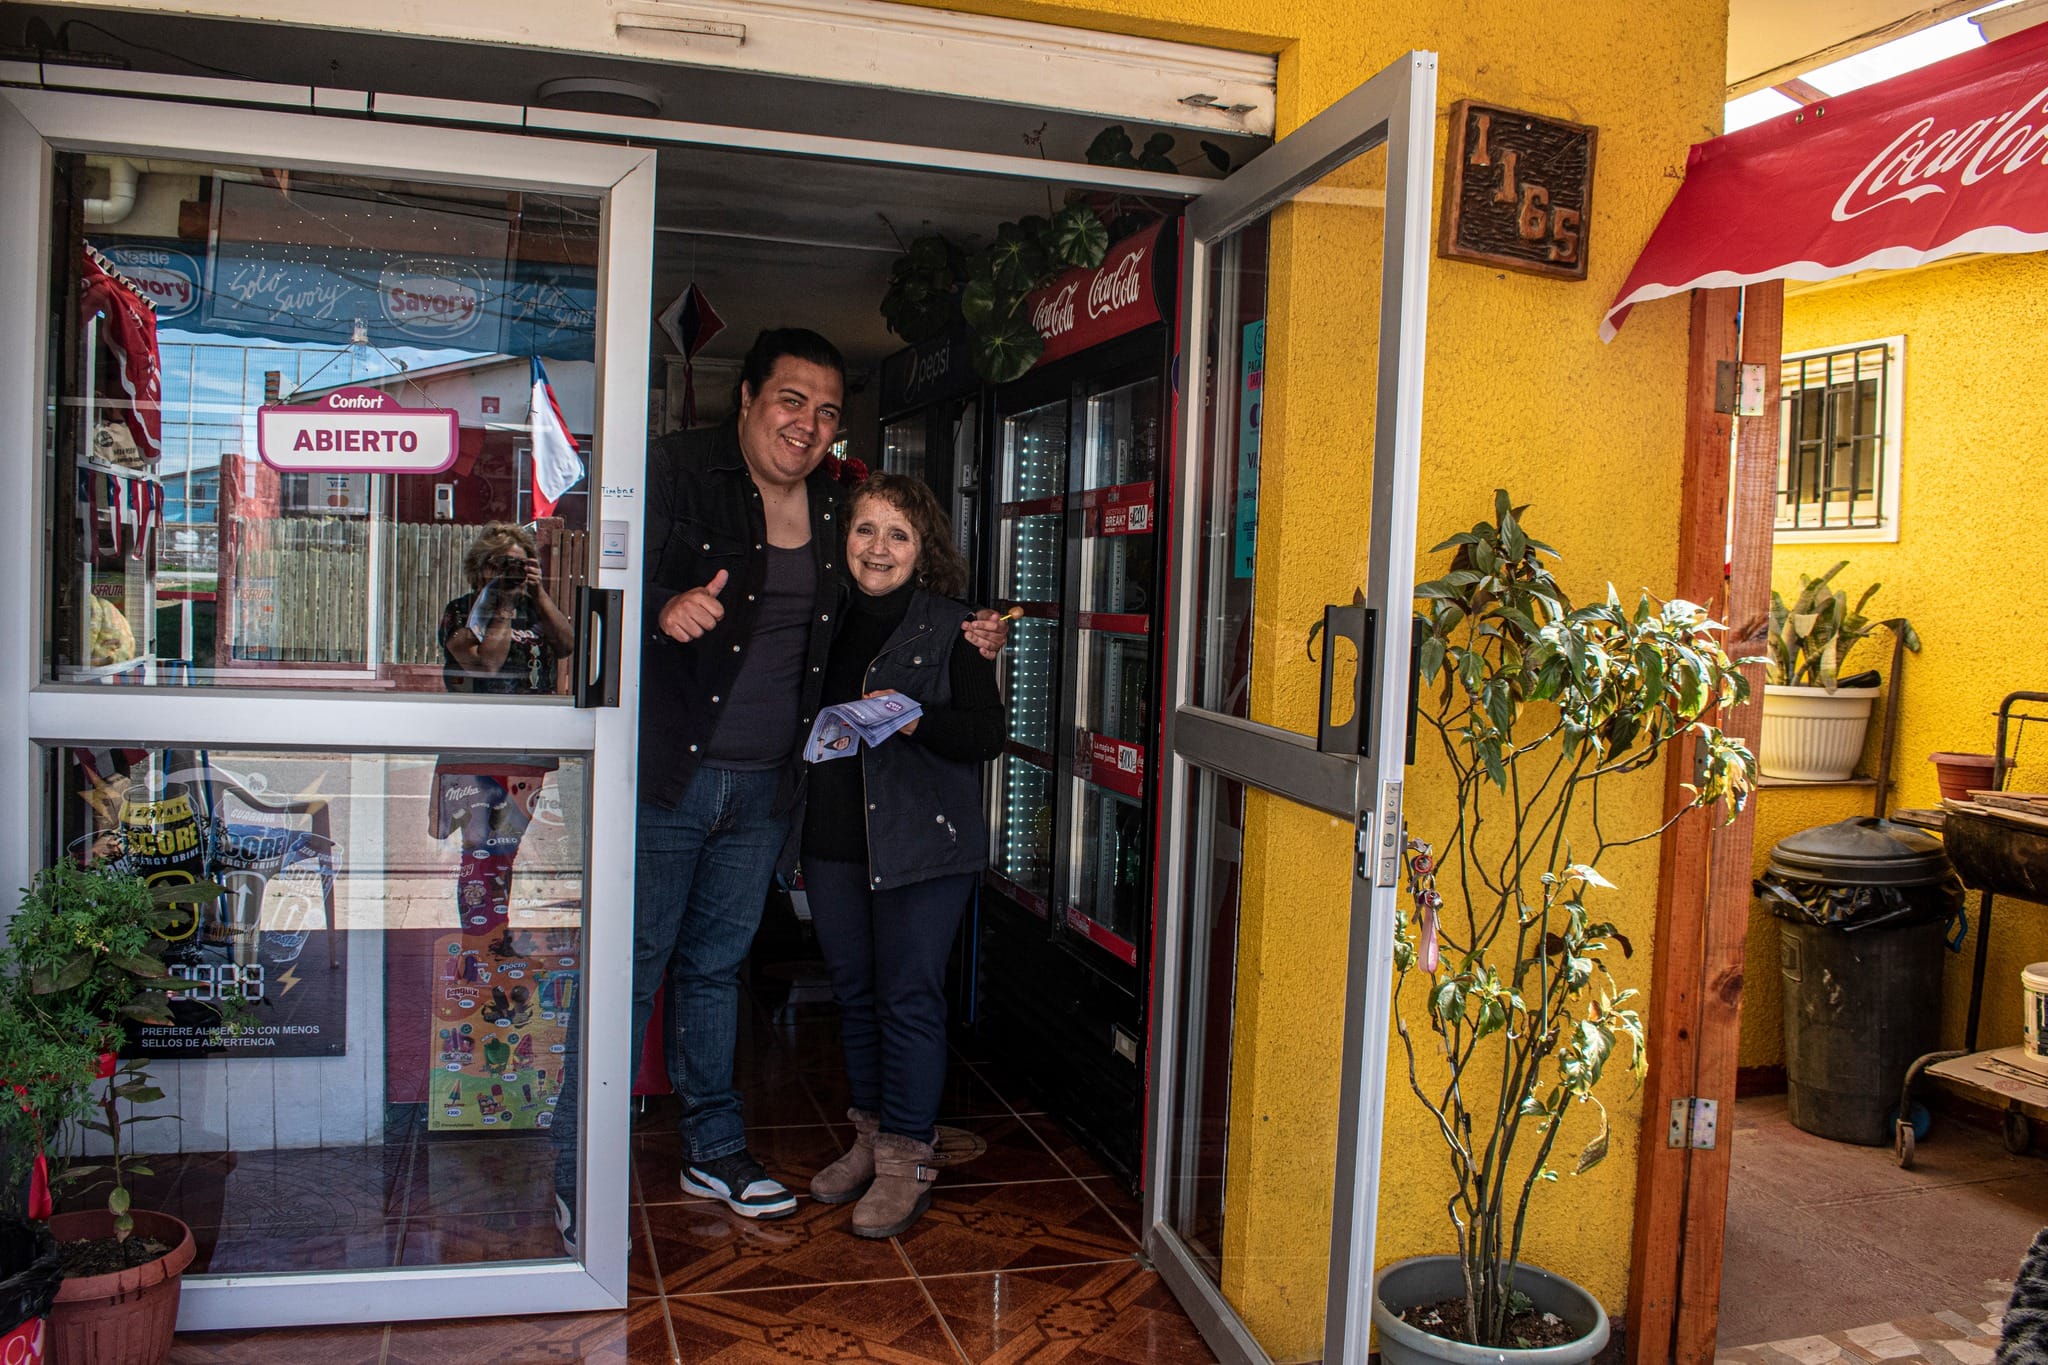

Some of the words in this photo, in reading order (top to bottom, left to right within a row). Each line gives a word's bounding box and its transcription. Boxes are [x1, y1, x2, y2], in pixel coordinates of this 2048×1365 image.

[1470, 114, 1580, 263] 1165
[1088, 246, 1147, 319] Coca-Cola
[390, 287, 475, 320] Savory
[917, 337, 950, 393] pepsi
[328, 393, 385, 410] Confort
[292, 429, 418, 453] ABIERTO
[445, 785, 481, 801] Milka
[486, 837, 518, 846] OREO
[141, 1027, 193, 1036] PREFIERE
[257, 1025, 280, 1036] CON
[282, 1025, 320, 1035] MENOS
[141, 1038, 183, 1048] SELLOS
[185, 1038, 200, 1048] DE
